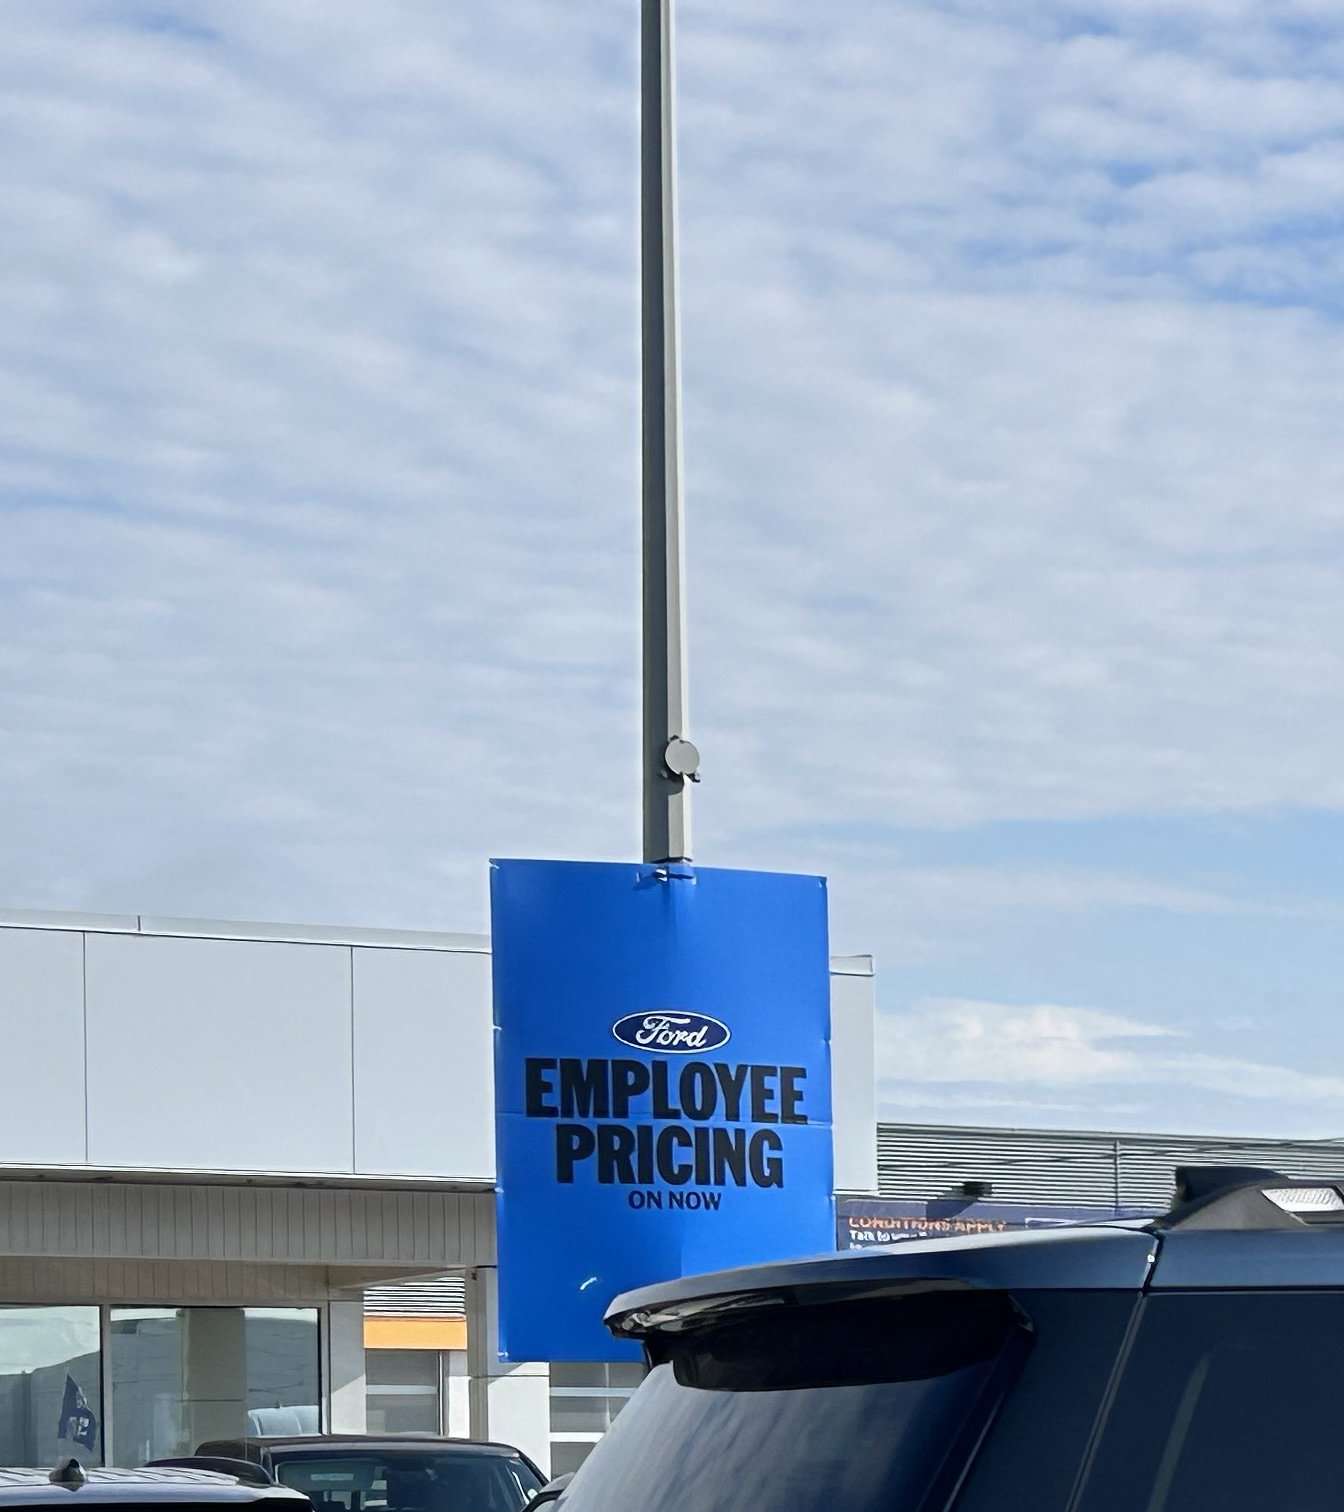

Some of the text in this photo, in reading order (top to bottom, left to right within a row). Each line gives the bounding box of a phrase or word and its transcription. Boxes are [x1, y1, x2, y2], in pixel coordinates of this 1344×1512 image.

[635, 1016, 708, 1048] Ford
[525, 1057, 809, 1125] EMPLOYEE
[556, 1123, 785, 1188] PRICING
[628, 1190, 722, 1211] ON NOW
